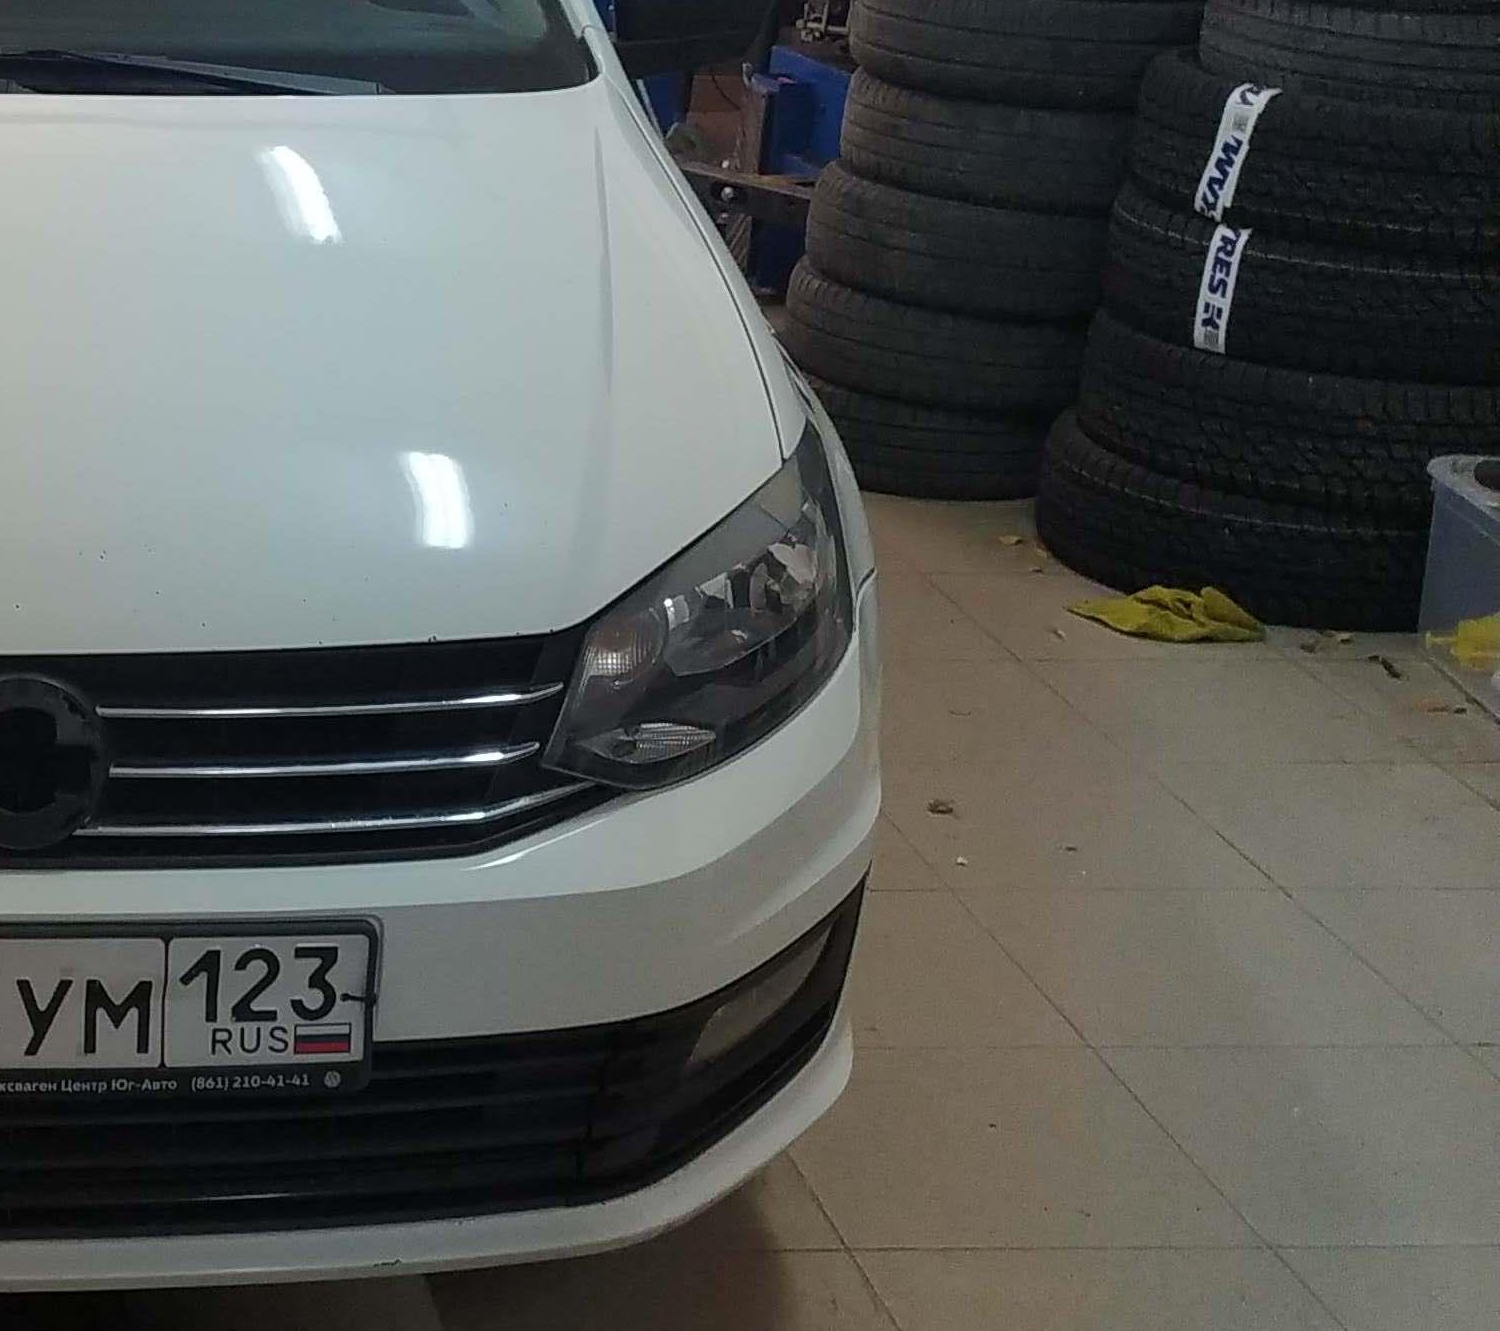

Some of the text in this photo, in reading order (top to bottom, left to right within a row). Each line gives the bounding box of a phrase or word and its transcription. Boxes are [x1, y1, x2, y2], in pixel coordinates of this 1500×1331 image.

[179, 945, 340, 1023] 123
[210, 1026, 290, 1055] RUS
[61, 1079, 108, 1094] Центр
[111, 1078, 178, 1091] Юг-Авто
[191, 1076, 229, 1092] (861)
[232, 1074, 310, 1088] 210-41-41
